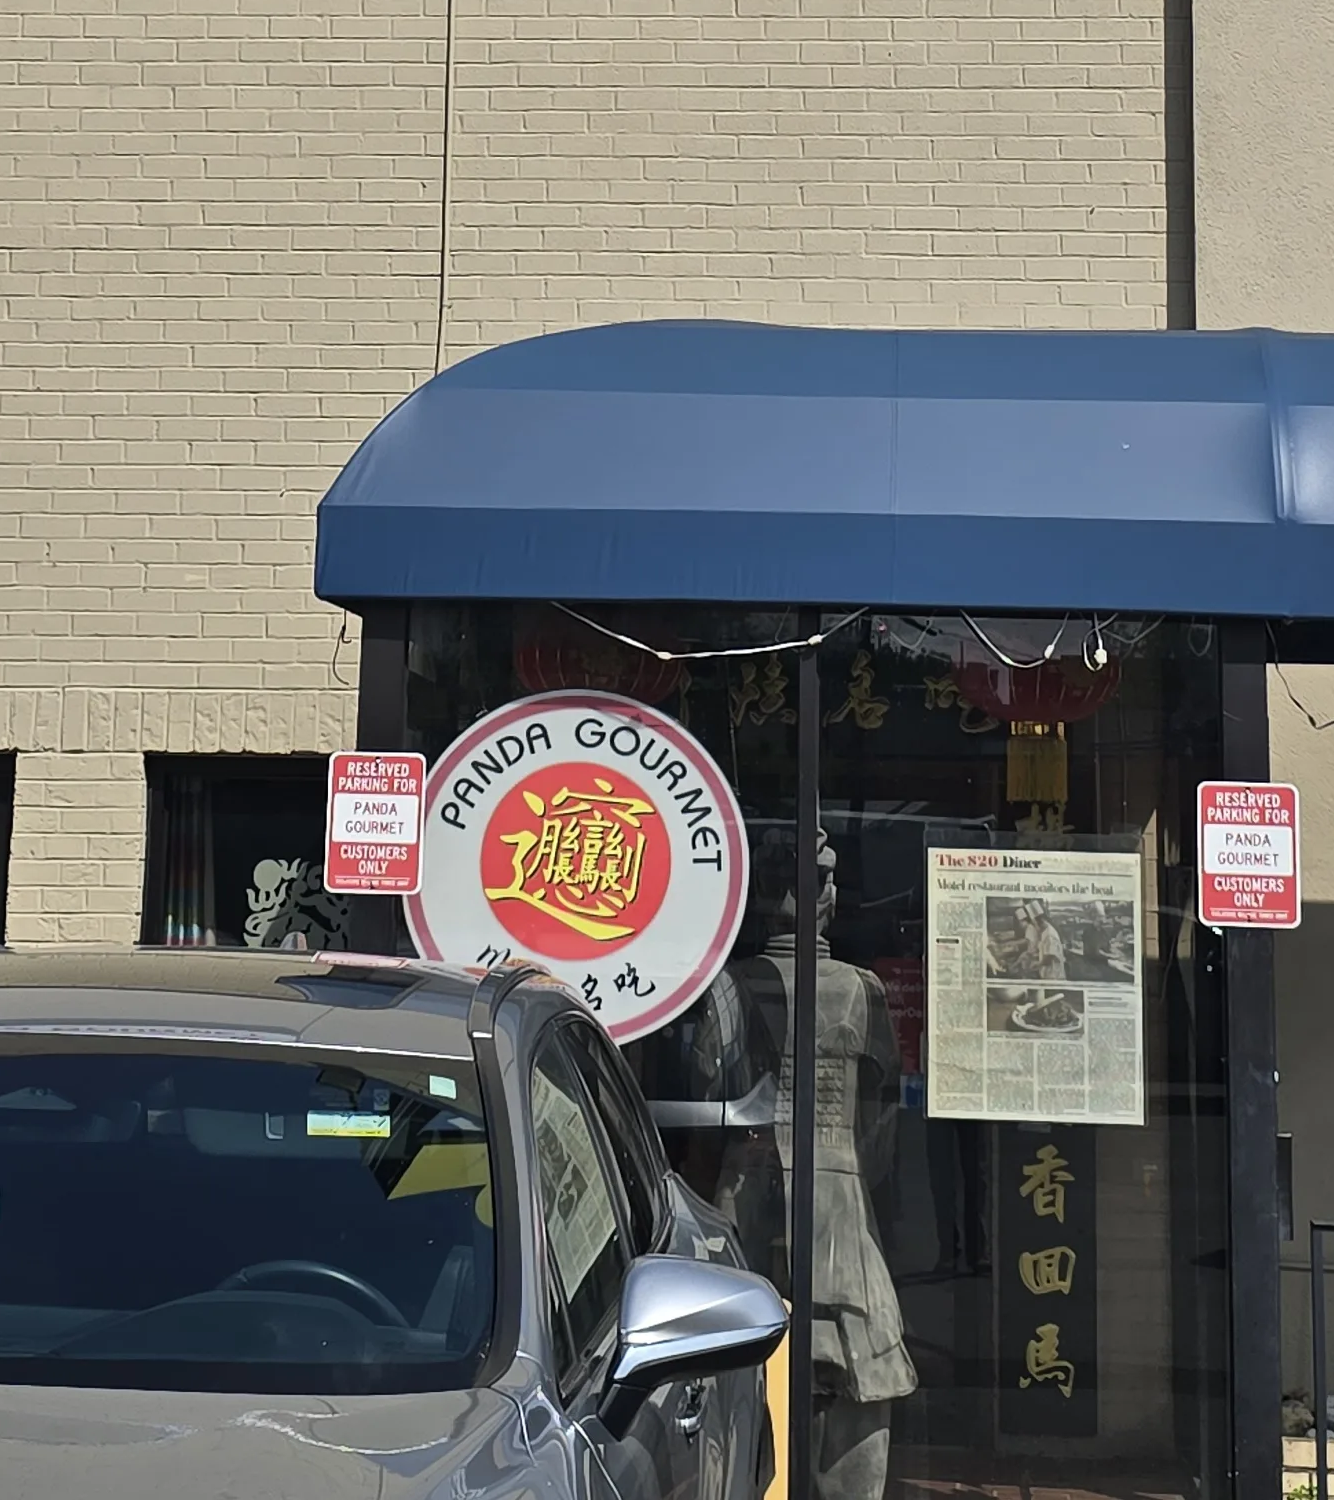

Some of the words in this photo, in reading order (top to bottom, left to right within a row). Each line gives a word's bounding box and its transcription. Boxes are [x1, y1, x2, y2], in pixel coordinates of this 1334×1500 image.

[347, 762, 410, 777] RESERVED
[338, 777, 389, 792] PARKING
[393, 779, 417, 793] FOR
[441, 723, 552, 830] PANDA
[574, 718, 723, 872] GOURMET
[1215, 792, 1280, 807] RESERVED
[353, 801, 398, 816] PANDA
[1207, 807, 1260, 823] PARKING
[1265, 809, 1290, 824] FOR
[345, 820, 405, 835] GOURMET
[1225, 832, 1272, 847] PANDA
[340, 845, 408, 860] CUSTOMERS
[1217, 852, 1279, 867] GOURMET
[358, 860, 389, 875] ONLY
[935, 854, 964, 868] The
[1002, 855, 1042, 869] Diner
[1214, 876, 1285, 893] CUSTOMERS
[1233, 893, 1265, 908] ONLY
